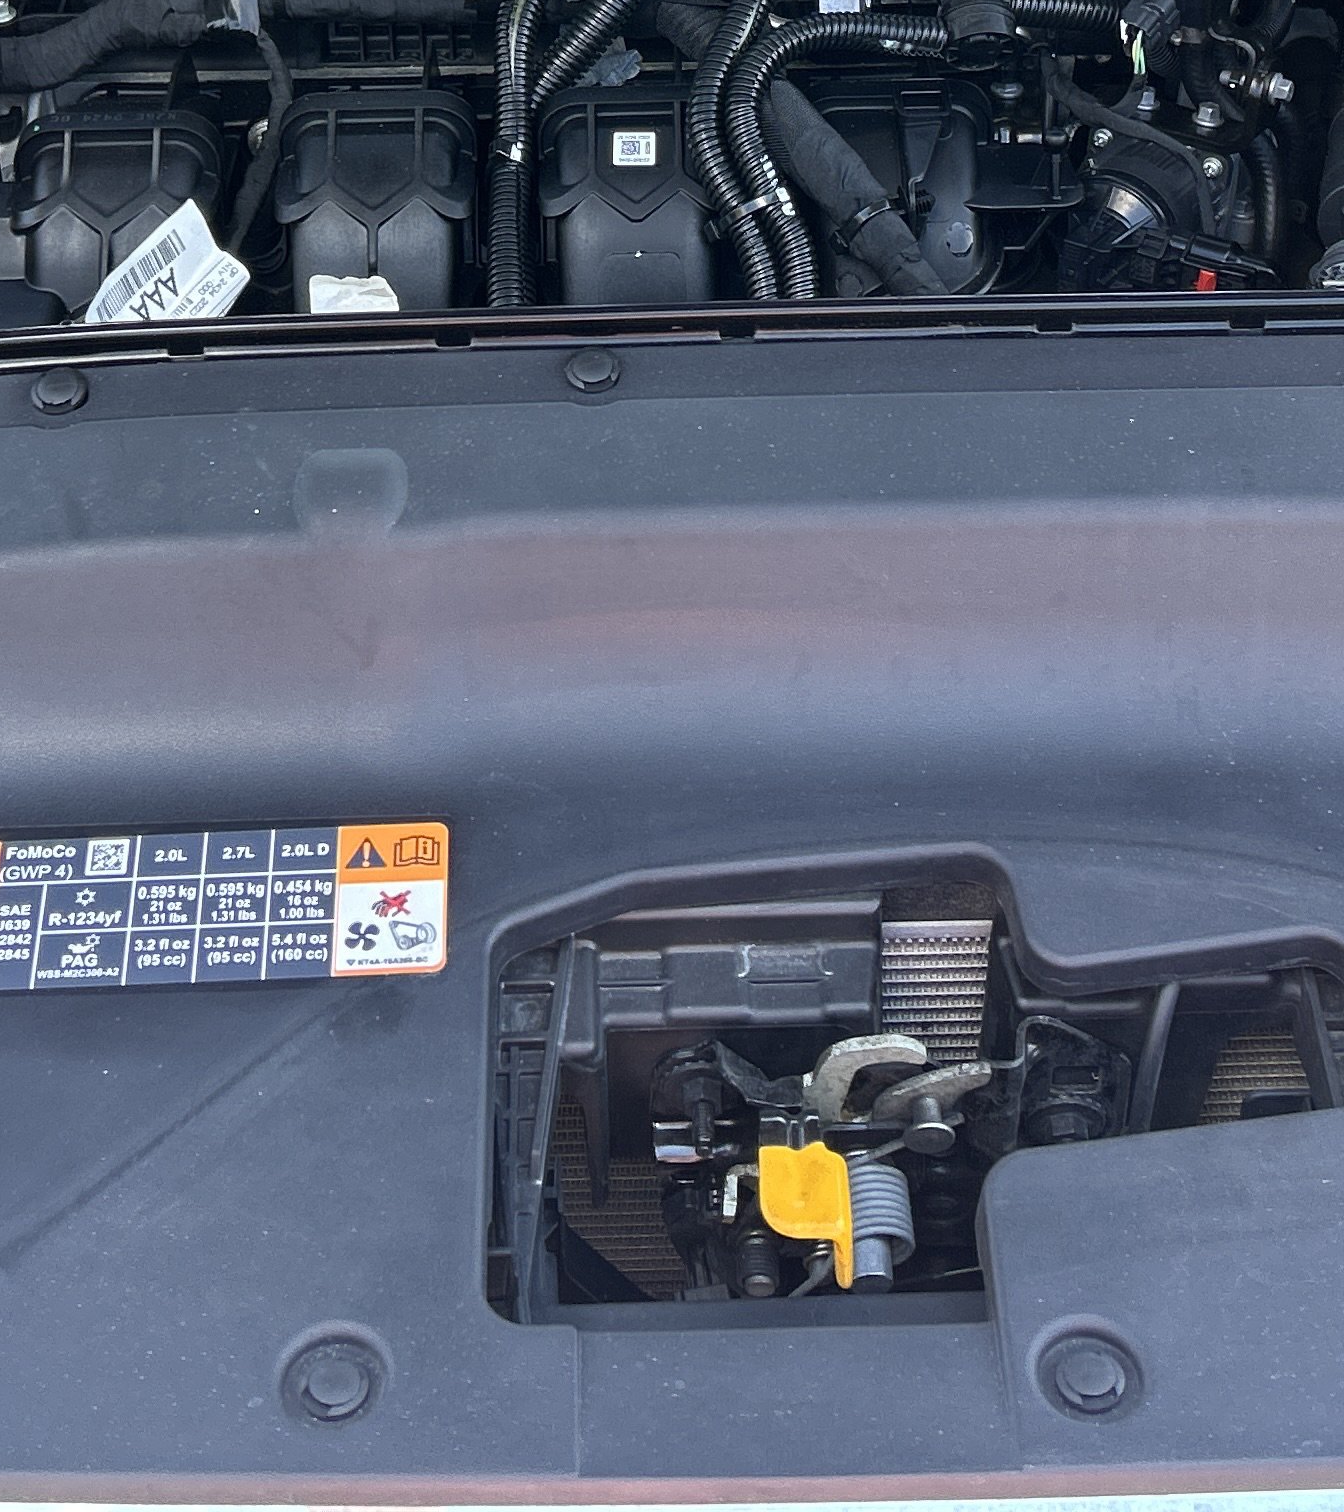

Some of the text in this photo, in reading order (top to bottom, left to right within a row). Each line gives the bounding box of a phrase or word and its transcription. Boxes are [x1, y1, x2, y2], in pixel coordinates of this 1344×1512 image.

[129, 267, 179, 320] AAA
[210, 278, 228, 298] 2434
[6, 845, 76, 860] FoMoCo
[154, 849, 188, 863] 2.0L
[222, 846, 256, 860] 2.7L
[281, 843, 330, 858] 2.0L D
[0, 864, 73, 883] (GWP 4)
[137, 885, 197, 901] 0.595 kg
[206, 882, 265, 898] 0.595 kg
[274, 880, 332, 896] 0.454 kg
[150, 901, 183, 912] 21 oz
[219, 898, 251, 909] 21 oz
[287, 895, 319, 906] 16 oz
[0, 904, 32, 917] SAE
[211, 911, 256, 922] 1.31 lbs
[279, 908, 324, 919] 1.00 lbs
[48, 910, 122, 927] R-1234yf
[142, 913, 188, 925] 1.31 lbs
[134, 938, 190, 952] 3.2 fl oz
[204, 936, 260, 949] 3.2 fl oz
[271, 933, 327, 946] 5.4 fl oz
[61, 954, 98, 968] PAG
[137, 953, 186, 969] (95 cc)
[207, 950, 256, 966] (95 cc)
[271, 948, 328, 963] (160 cc)
